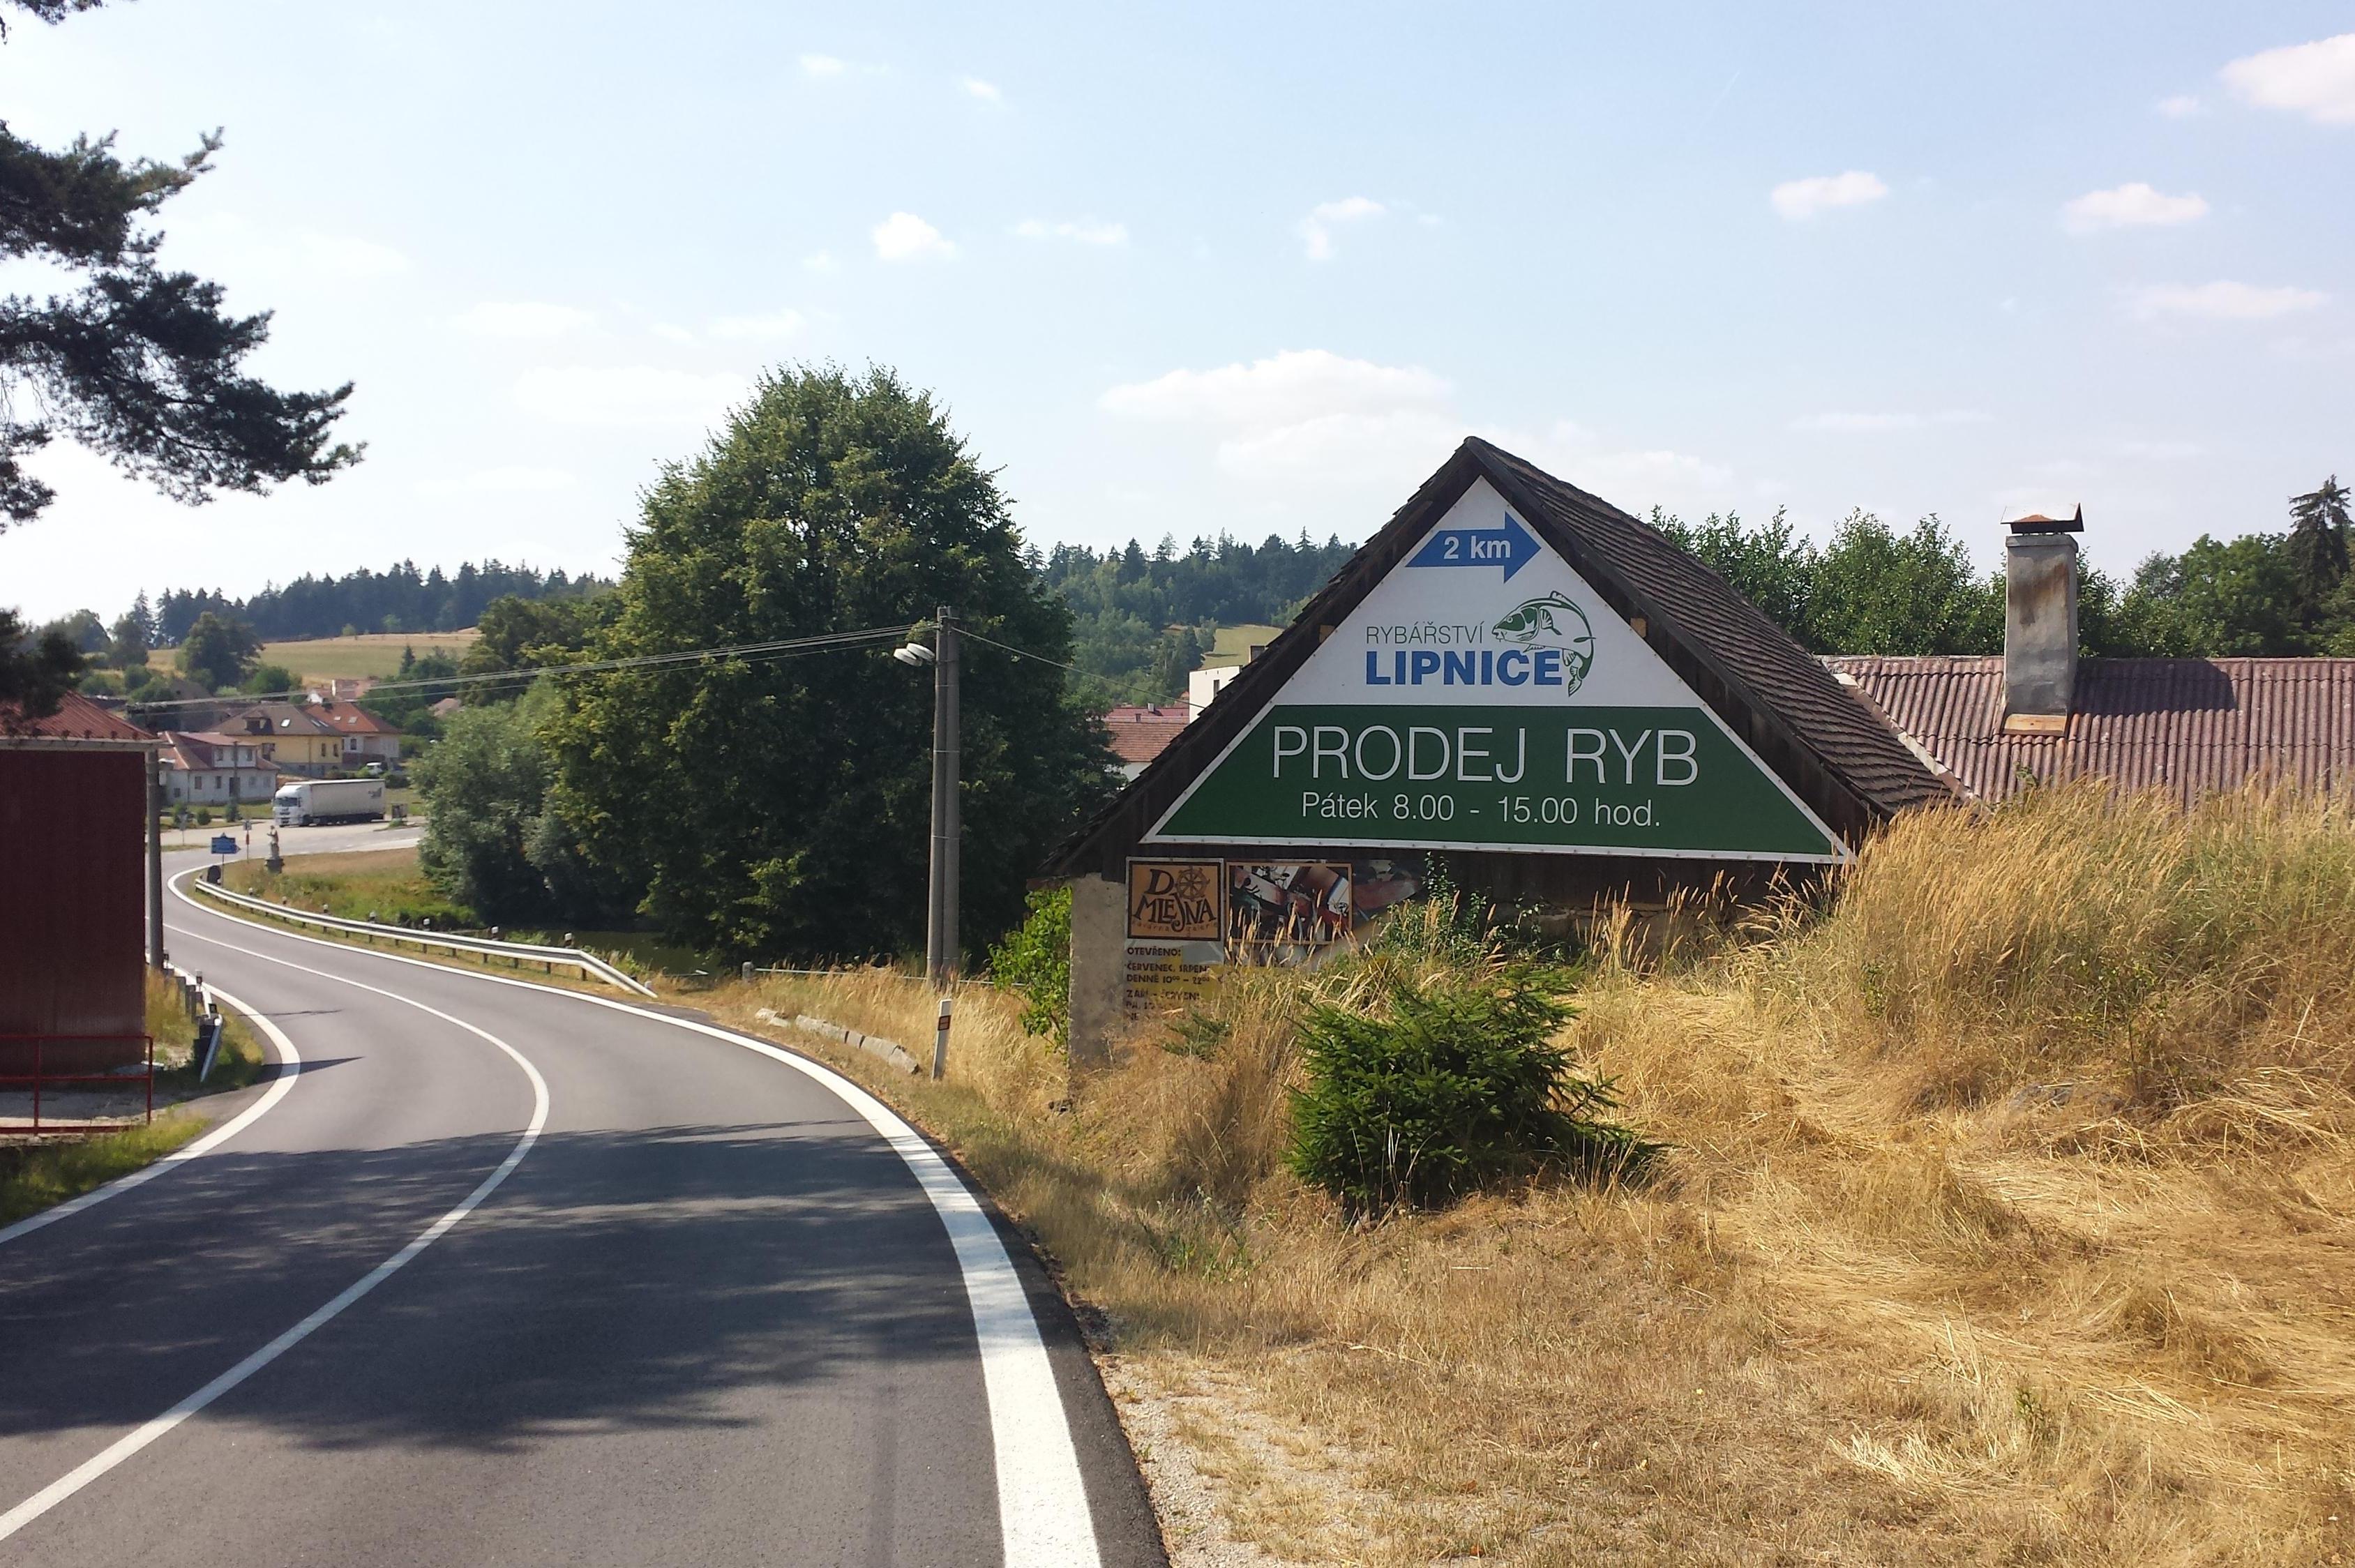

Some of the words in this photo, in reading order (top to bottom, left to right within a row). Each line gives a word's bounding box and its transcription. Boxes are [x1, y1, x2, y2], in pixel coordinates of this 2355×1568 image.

[1443, 536, 1459, 559] 2
[1470, 535, 1511, 559] km
[1366, 620, 1485, 644] RYBÁŘSTVÍ
[1365, 649, 1563, 686] LIPNICE
[1273, 724, 1526, 783] PRODEJ
[1565, 728, 1699, 786] RYB
[1301, 791, 1379, 819] Pátek
[1393, 793, 1455, 821] 8.00
[1497, 796, 1579, 824] 15.00
[1594, 797, 1661, 827] hod.
[1131, 893, 1217, 932] MLEJNA
[1127, 946, 1181, 956] OTEVŘENO:
